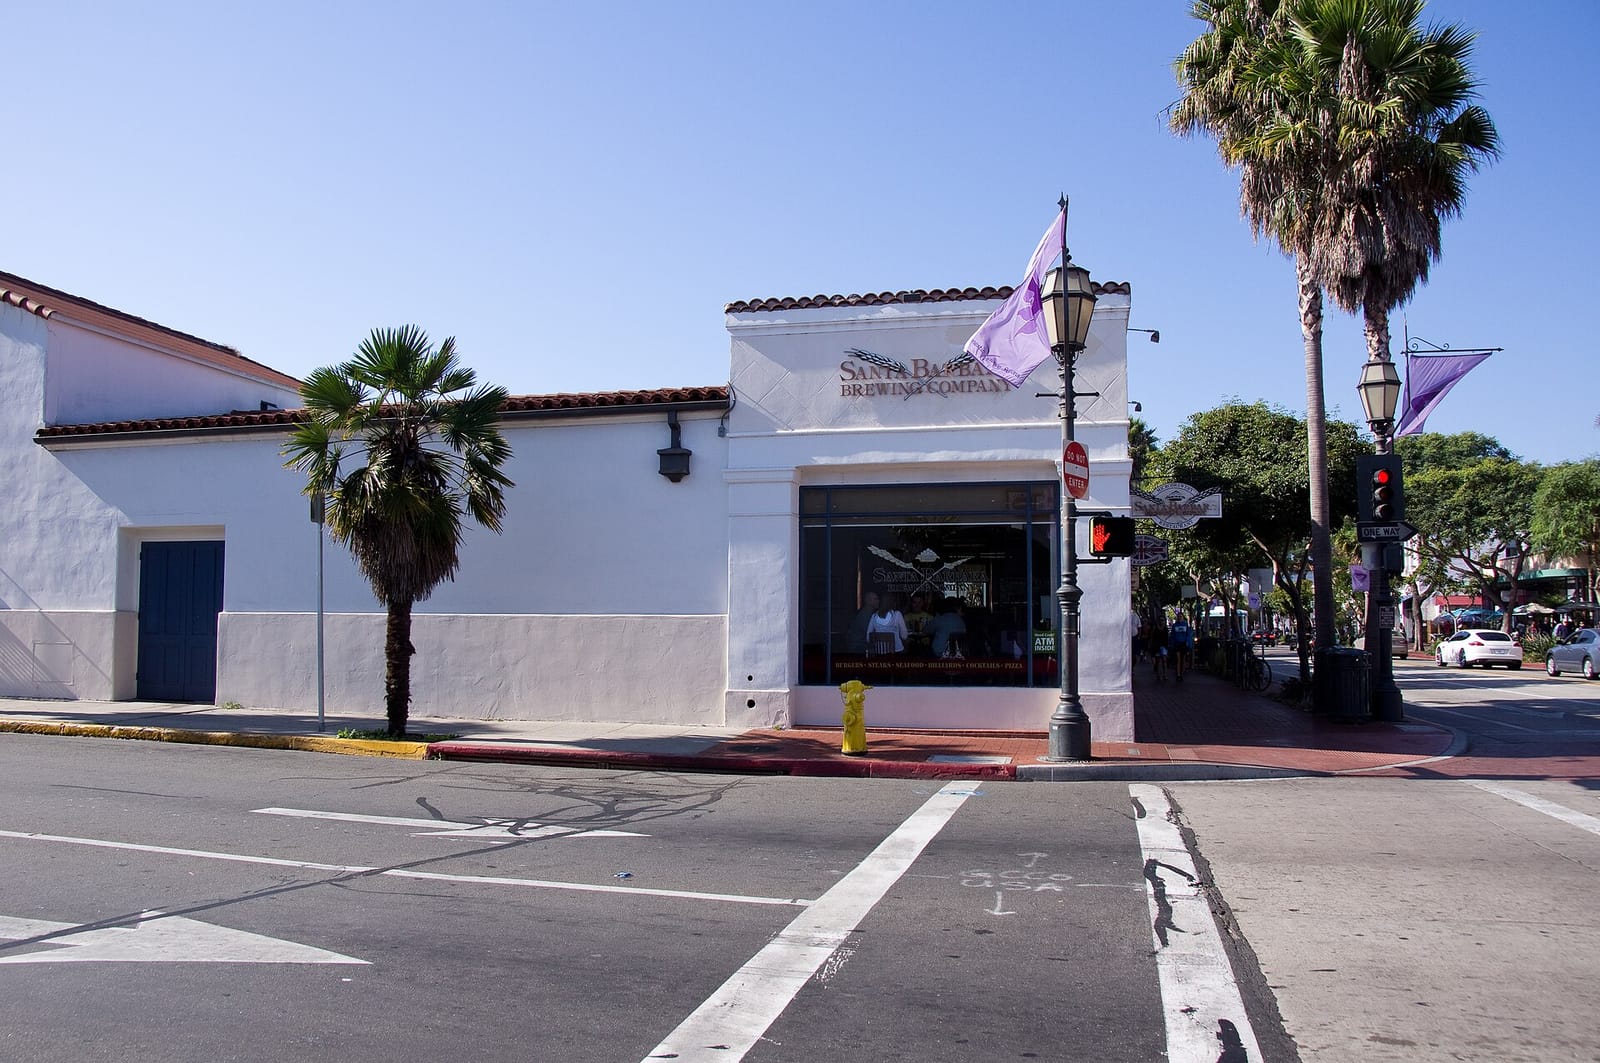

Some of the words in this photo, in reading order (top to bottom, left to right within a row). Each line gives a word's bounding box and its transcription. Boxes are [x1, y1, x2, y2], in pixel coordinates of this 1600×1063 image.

[840, 360, 906, 381] SANTA
[911, 358, 990, 379] BARBA
[840, 382, 924, 398] BREWING
[927, 379, 1012, 395] COMPANY
[1067, 451, 1075, 460] DO
[1076, 454, 1086, 464] NOT
[1068, 477, 1085, 489] ENTER
[1364, 528, 1381, 536] ONE
[1383, 527, 1400, 536] WAY
[1034, 638, 1055, 646] ATM
